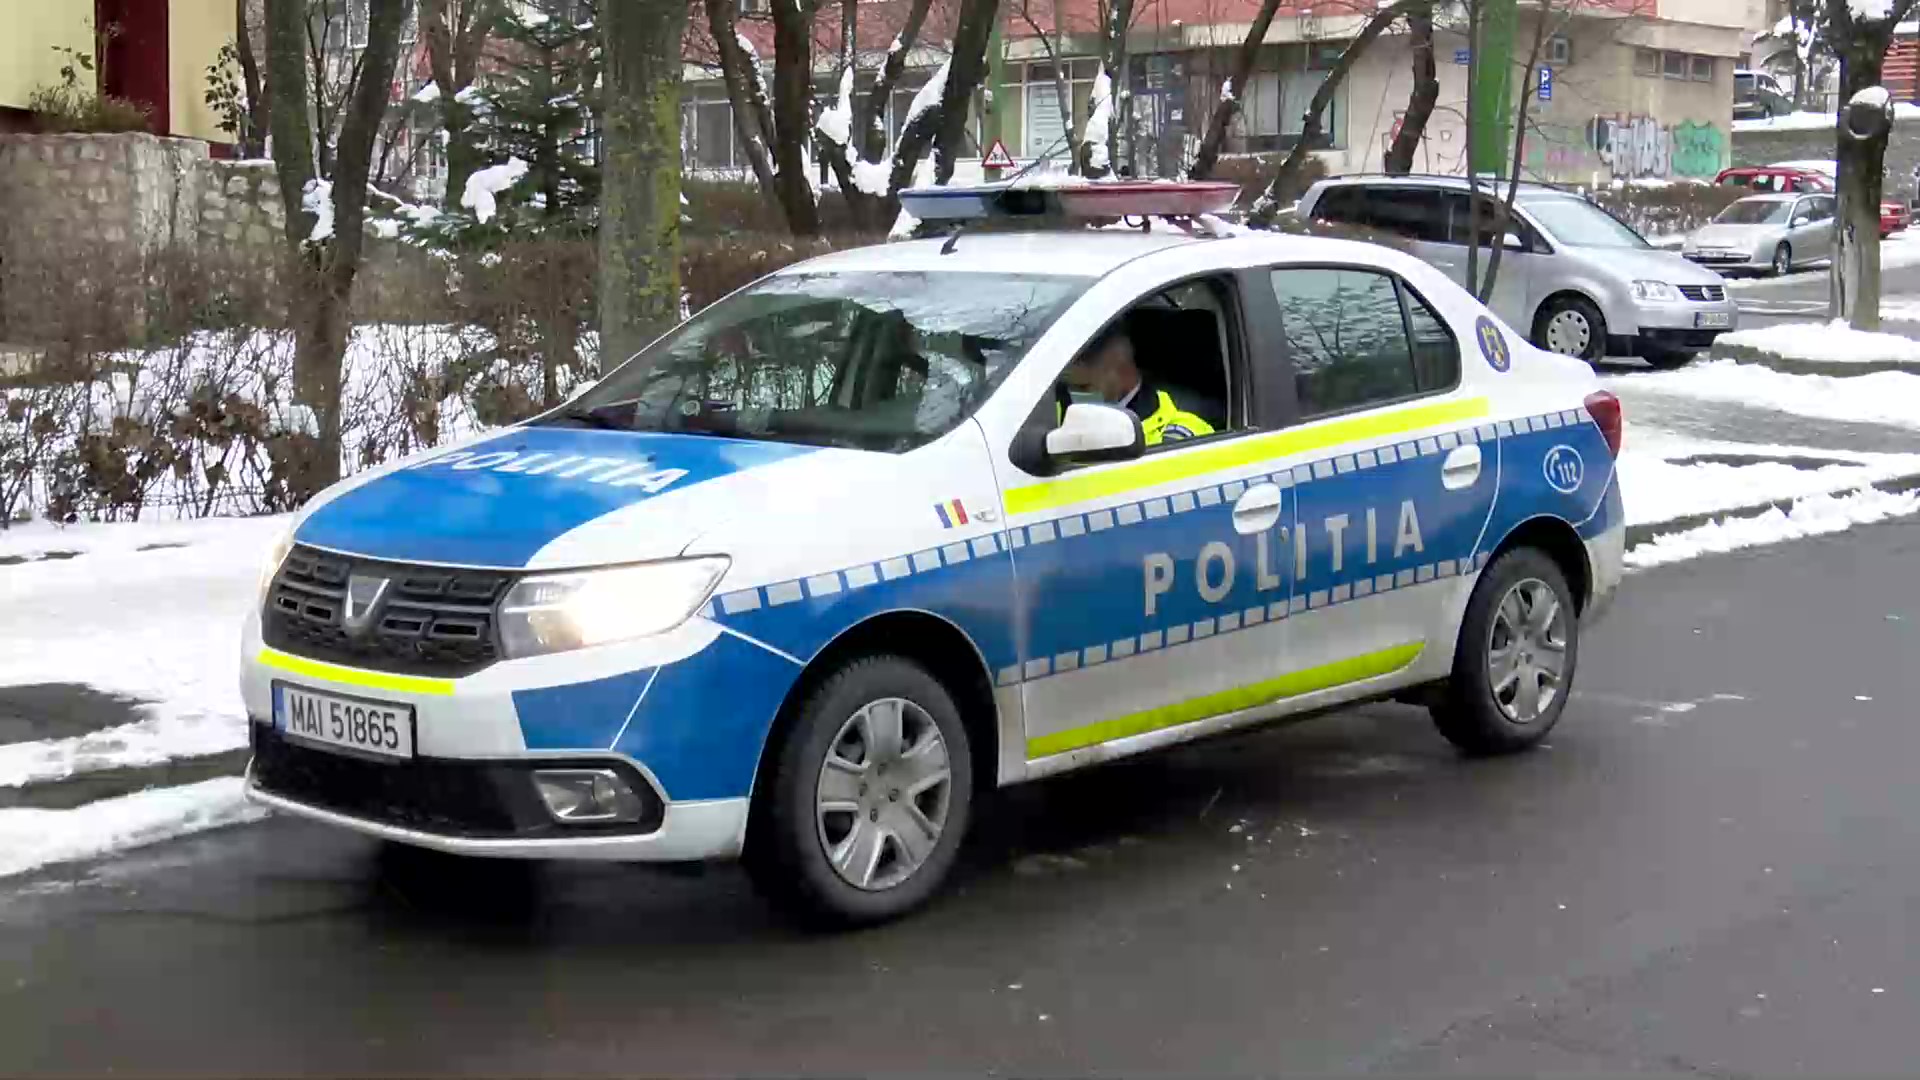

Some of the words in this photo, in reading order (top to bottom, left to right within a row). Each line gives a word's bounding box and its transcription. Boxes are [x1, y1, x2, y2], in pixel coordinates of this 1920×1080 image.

[1541, 69, 1549, 84] P
[430, 451, 691, 493] POLITIA
[1557, 461, 1578, 484] 112
[1143, 499, 1425, 617] POLITIA
[290, 693, 323, 737] MAI
[329, 701, 399, 749] 51865
